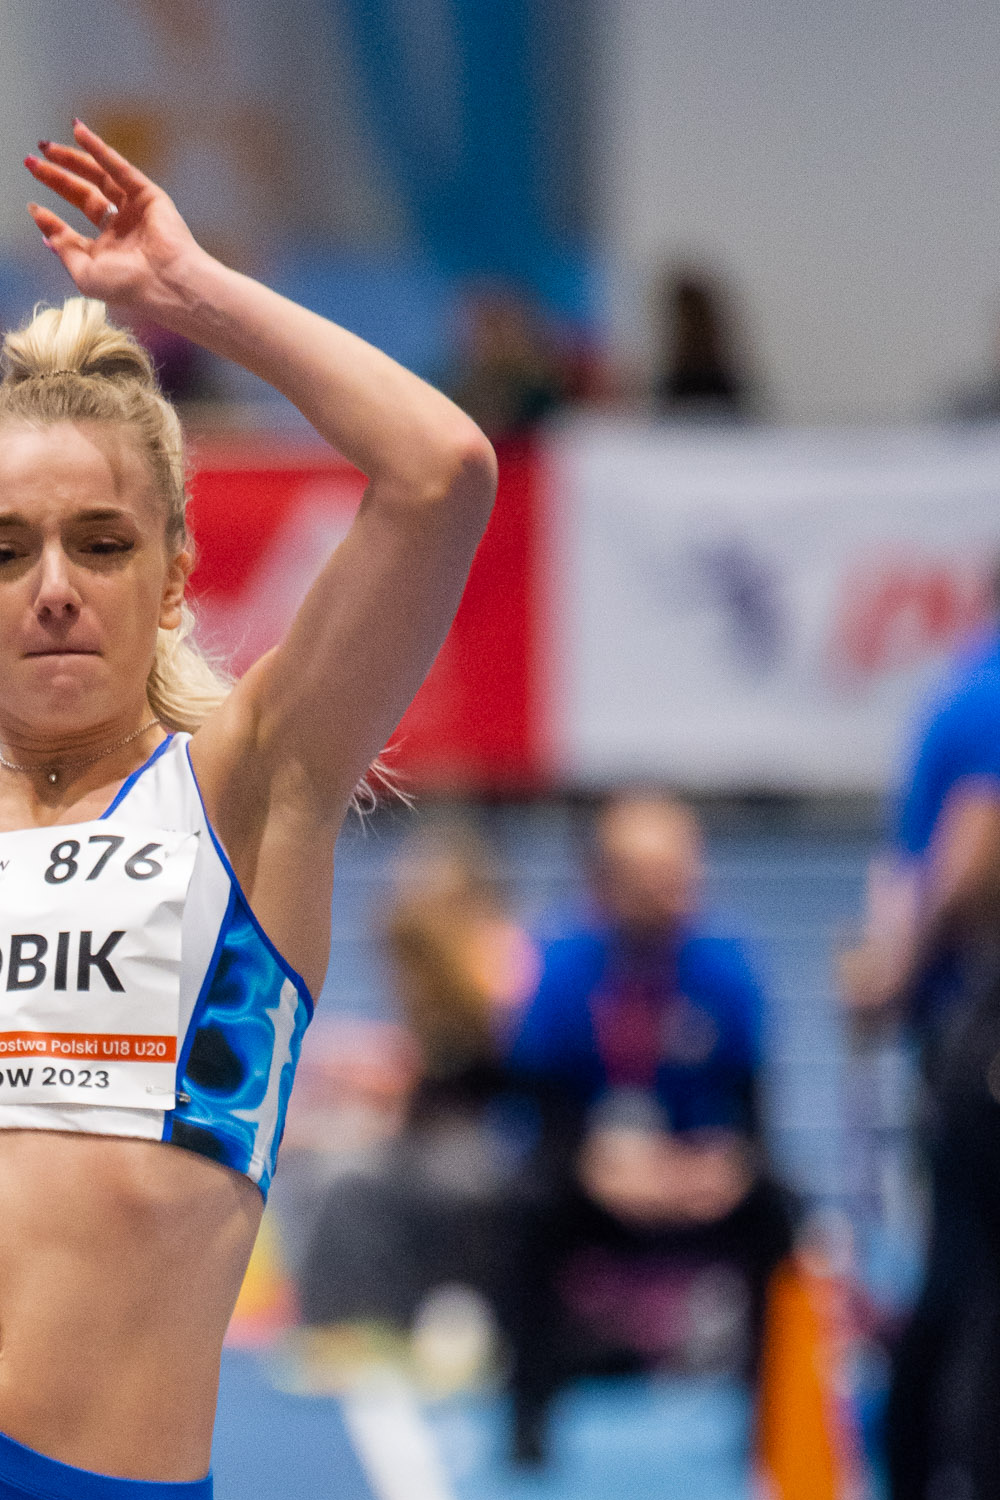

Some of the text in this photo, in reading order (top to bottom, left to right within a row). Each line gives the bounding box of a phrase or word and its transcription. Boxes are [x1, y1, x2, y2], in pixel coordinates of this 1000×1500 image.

[44, 835, 163, 885] 876
[51, 1040, 98, 1054] Polski
[103, 1041, 130, 1055] U18
[135, 1042, 167, 1057] U20
[42, 1066, 110, 1089] 2023
